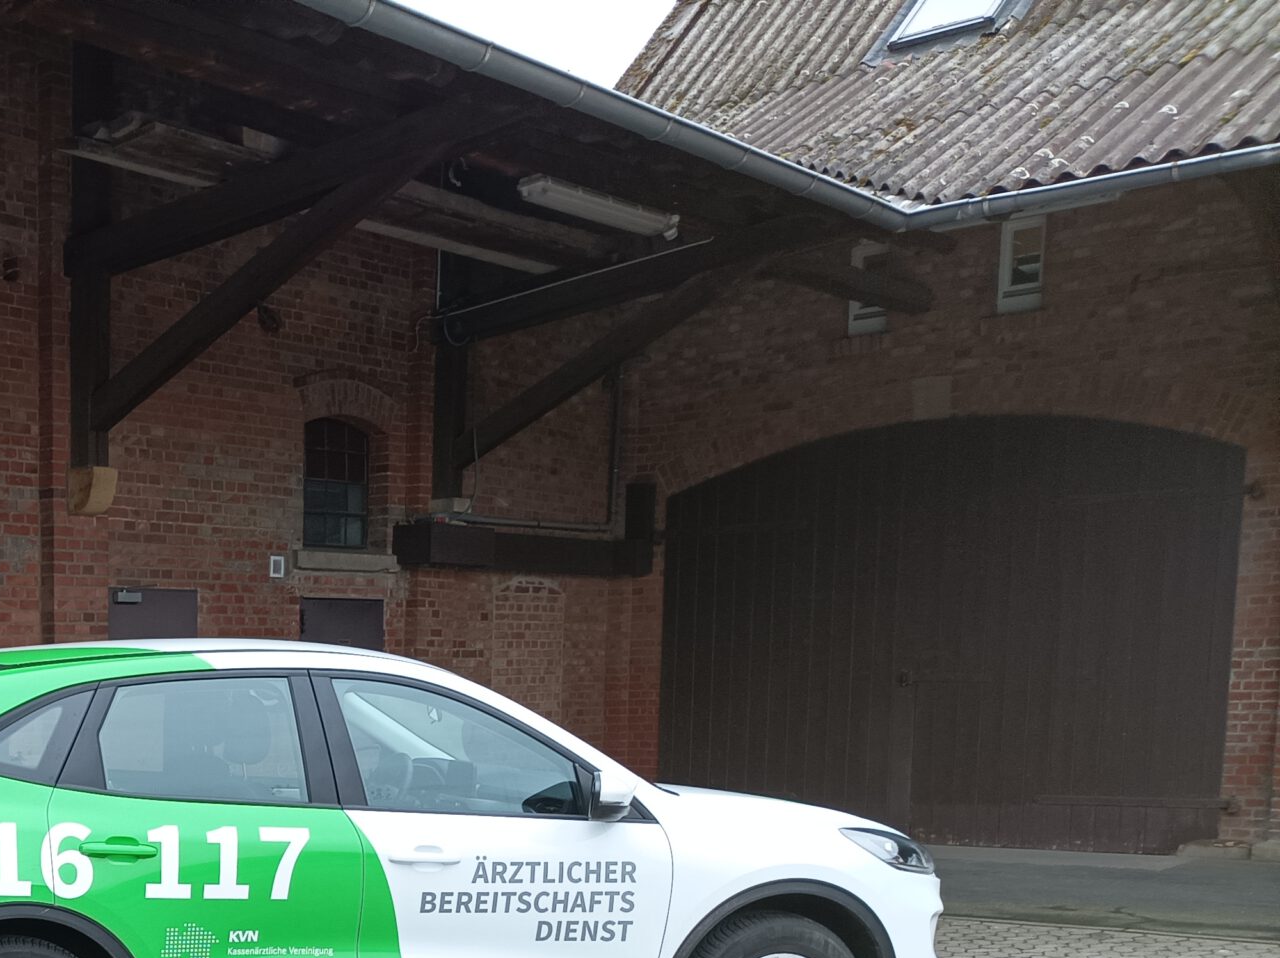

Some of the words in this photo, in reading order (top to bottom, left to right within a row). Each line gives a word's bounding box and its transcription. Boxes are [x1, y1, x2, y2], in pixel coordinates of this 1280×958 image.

[144, 824, 311, 900] 117
[471, 855, 637, 884] ÄRZTLICHER
[419, 890, 636, 914] BEREITSCHAFTS
[228, 930, 259, 943] KVN
[534, 919, 634, 942] DIENST
[227, 946, 287, 956] Kassenärztliche
[288, 946, 334, 957] Vereinigung
